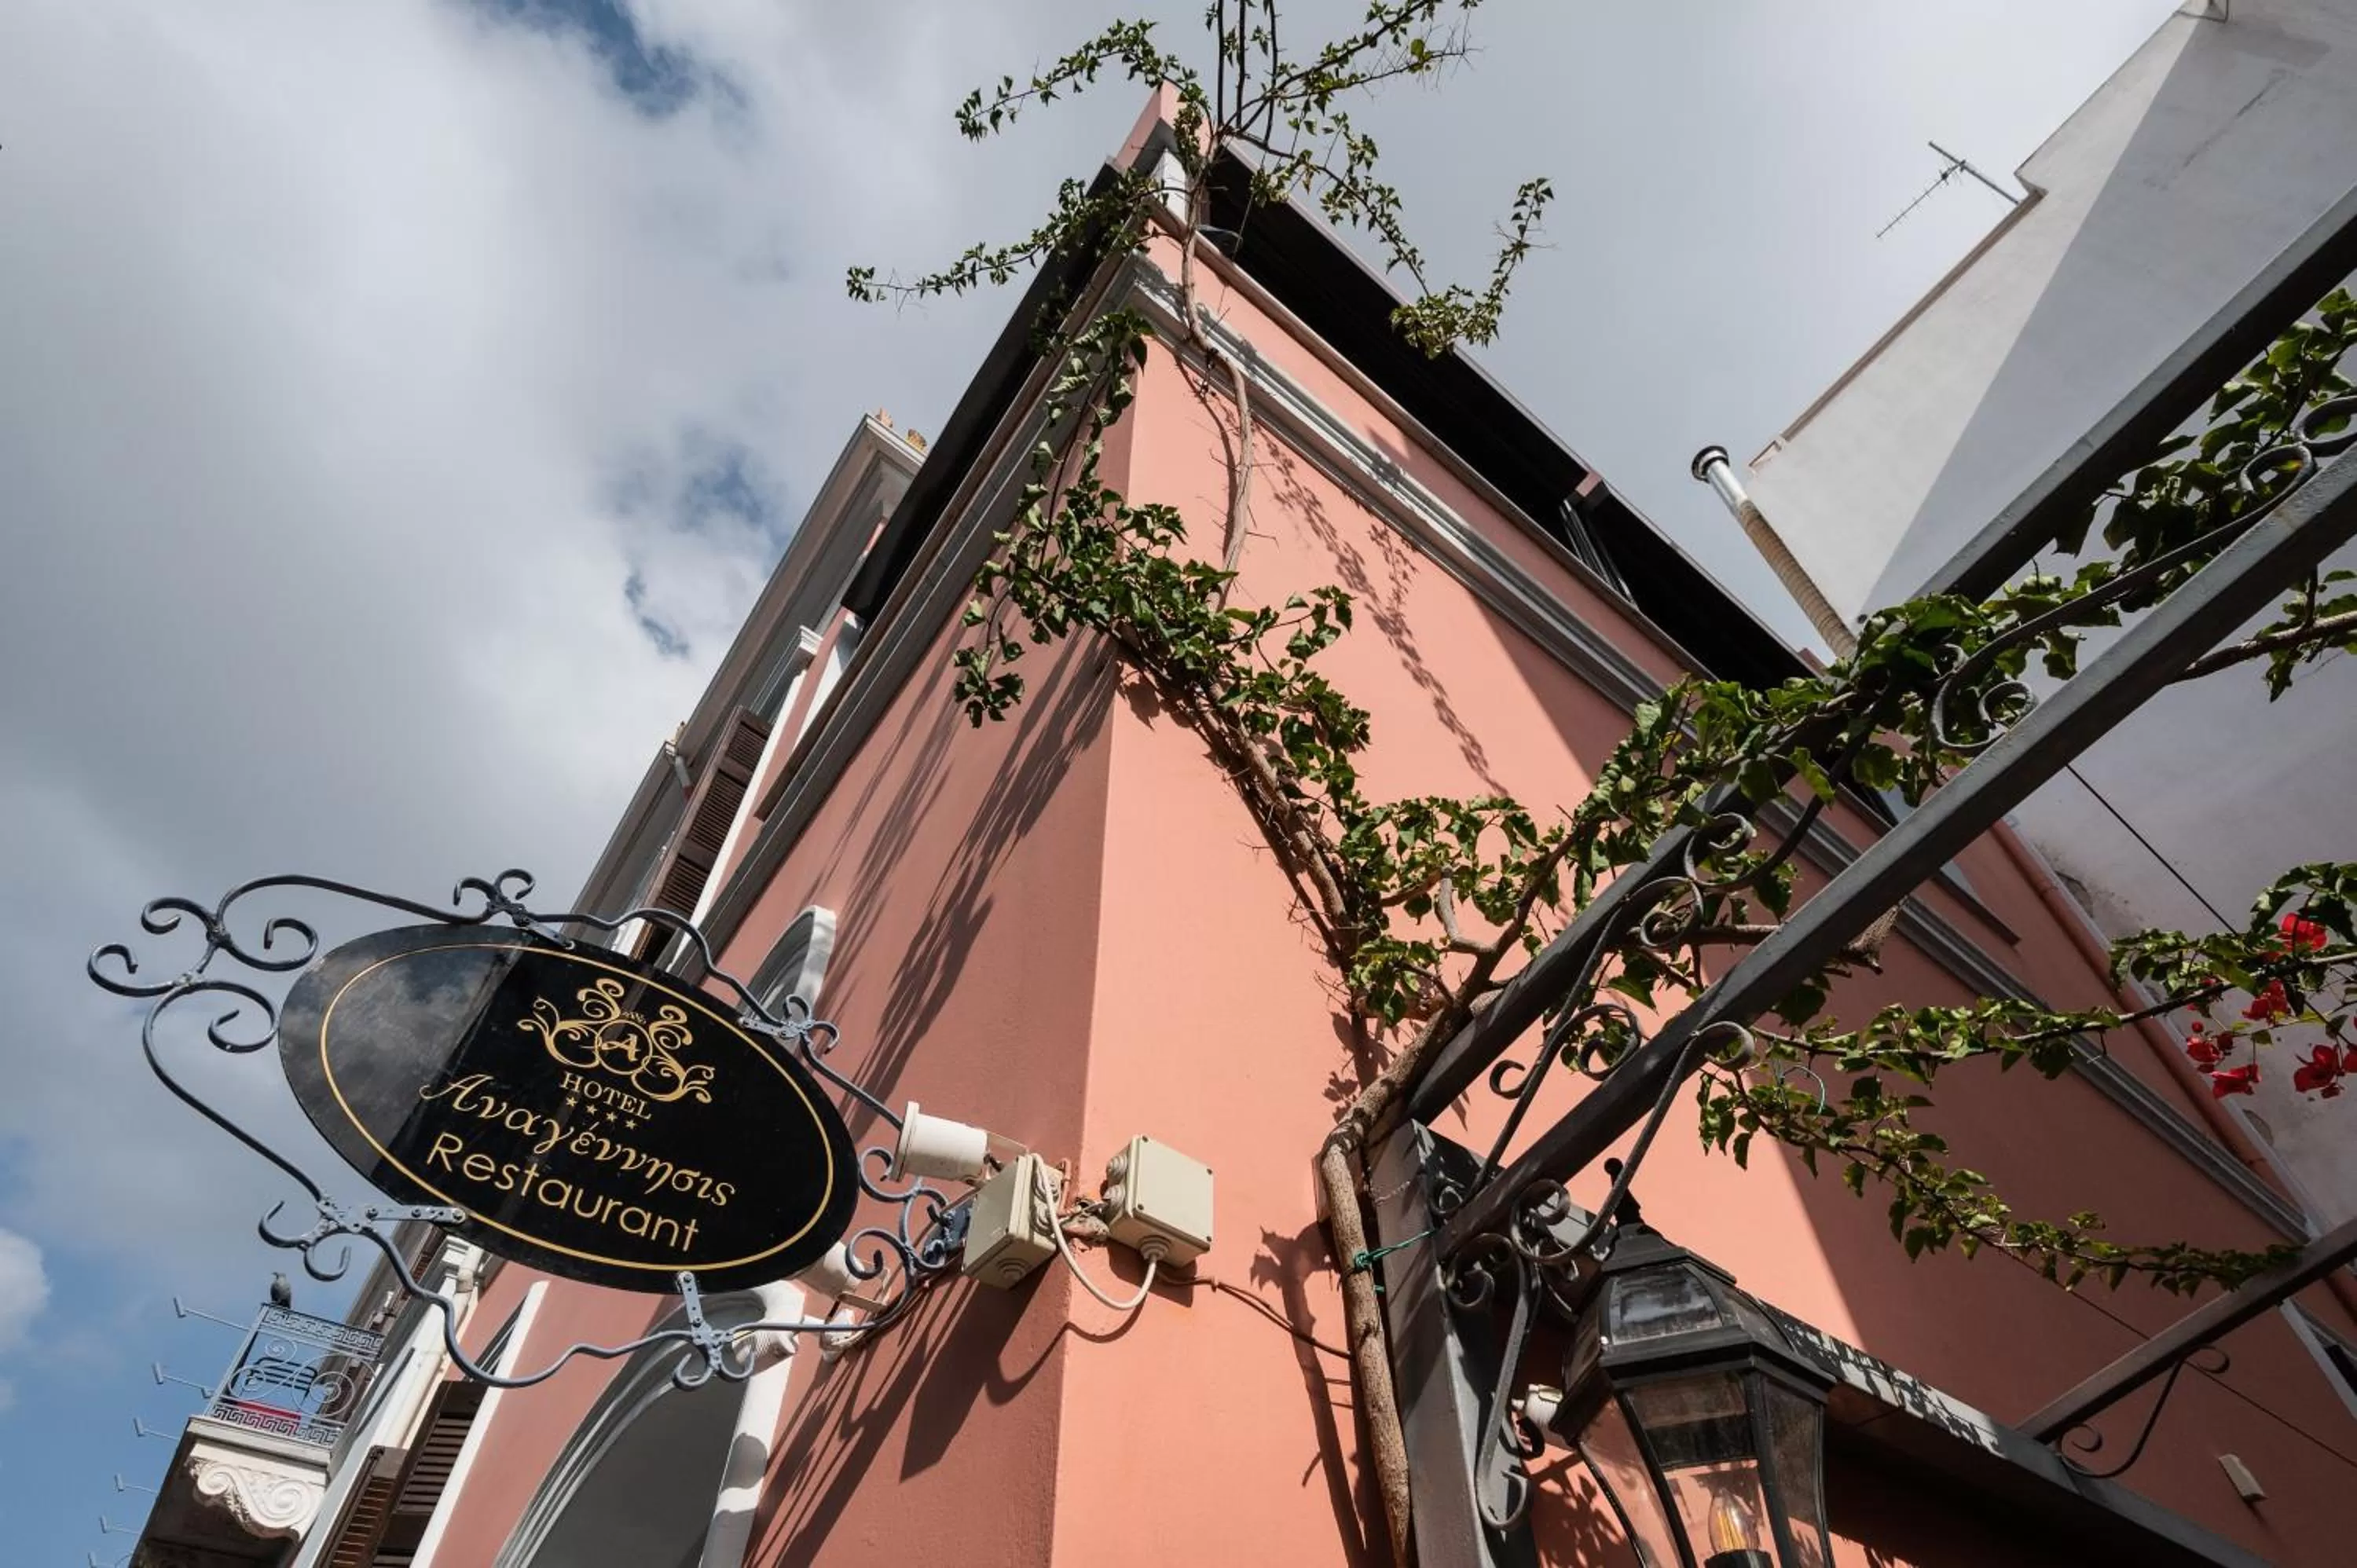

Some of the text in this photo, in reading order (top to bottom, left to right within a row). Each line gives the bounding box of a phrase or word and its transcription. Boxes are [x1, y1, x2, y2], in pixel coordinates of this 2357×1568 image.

[419, 1074, 735, 1206] Αναγέννησις
[559, 1071, 653, 1120] HOTEL
[427, 1132, 699, 1251] Restaurant
